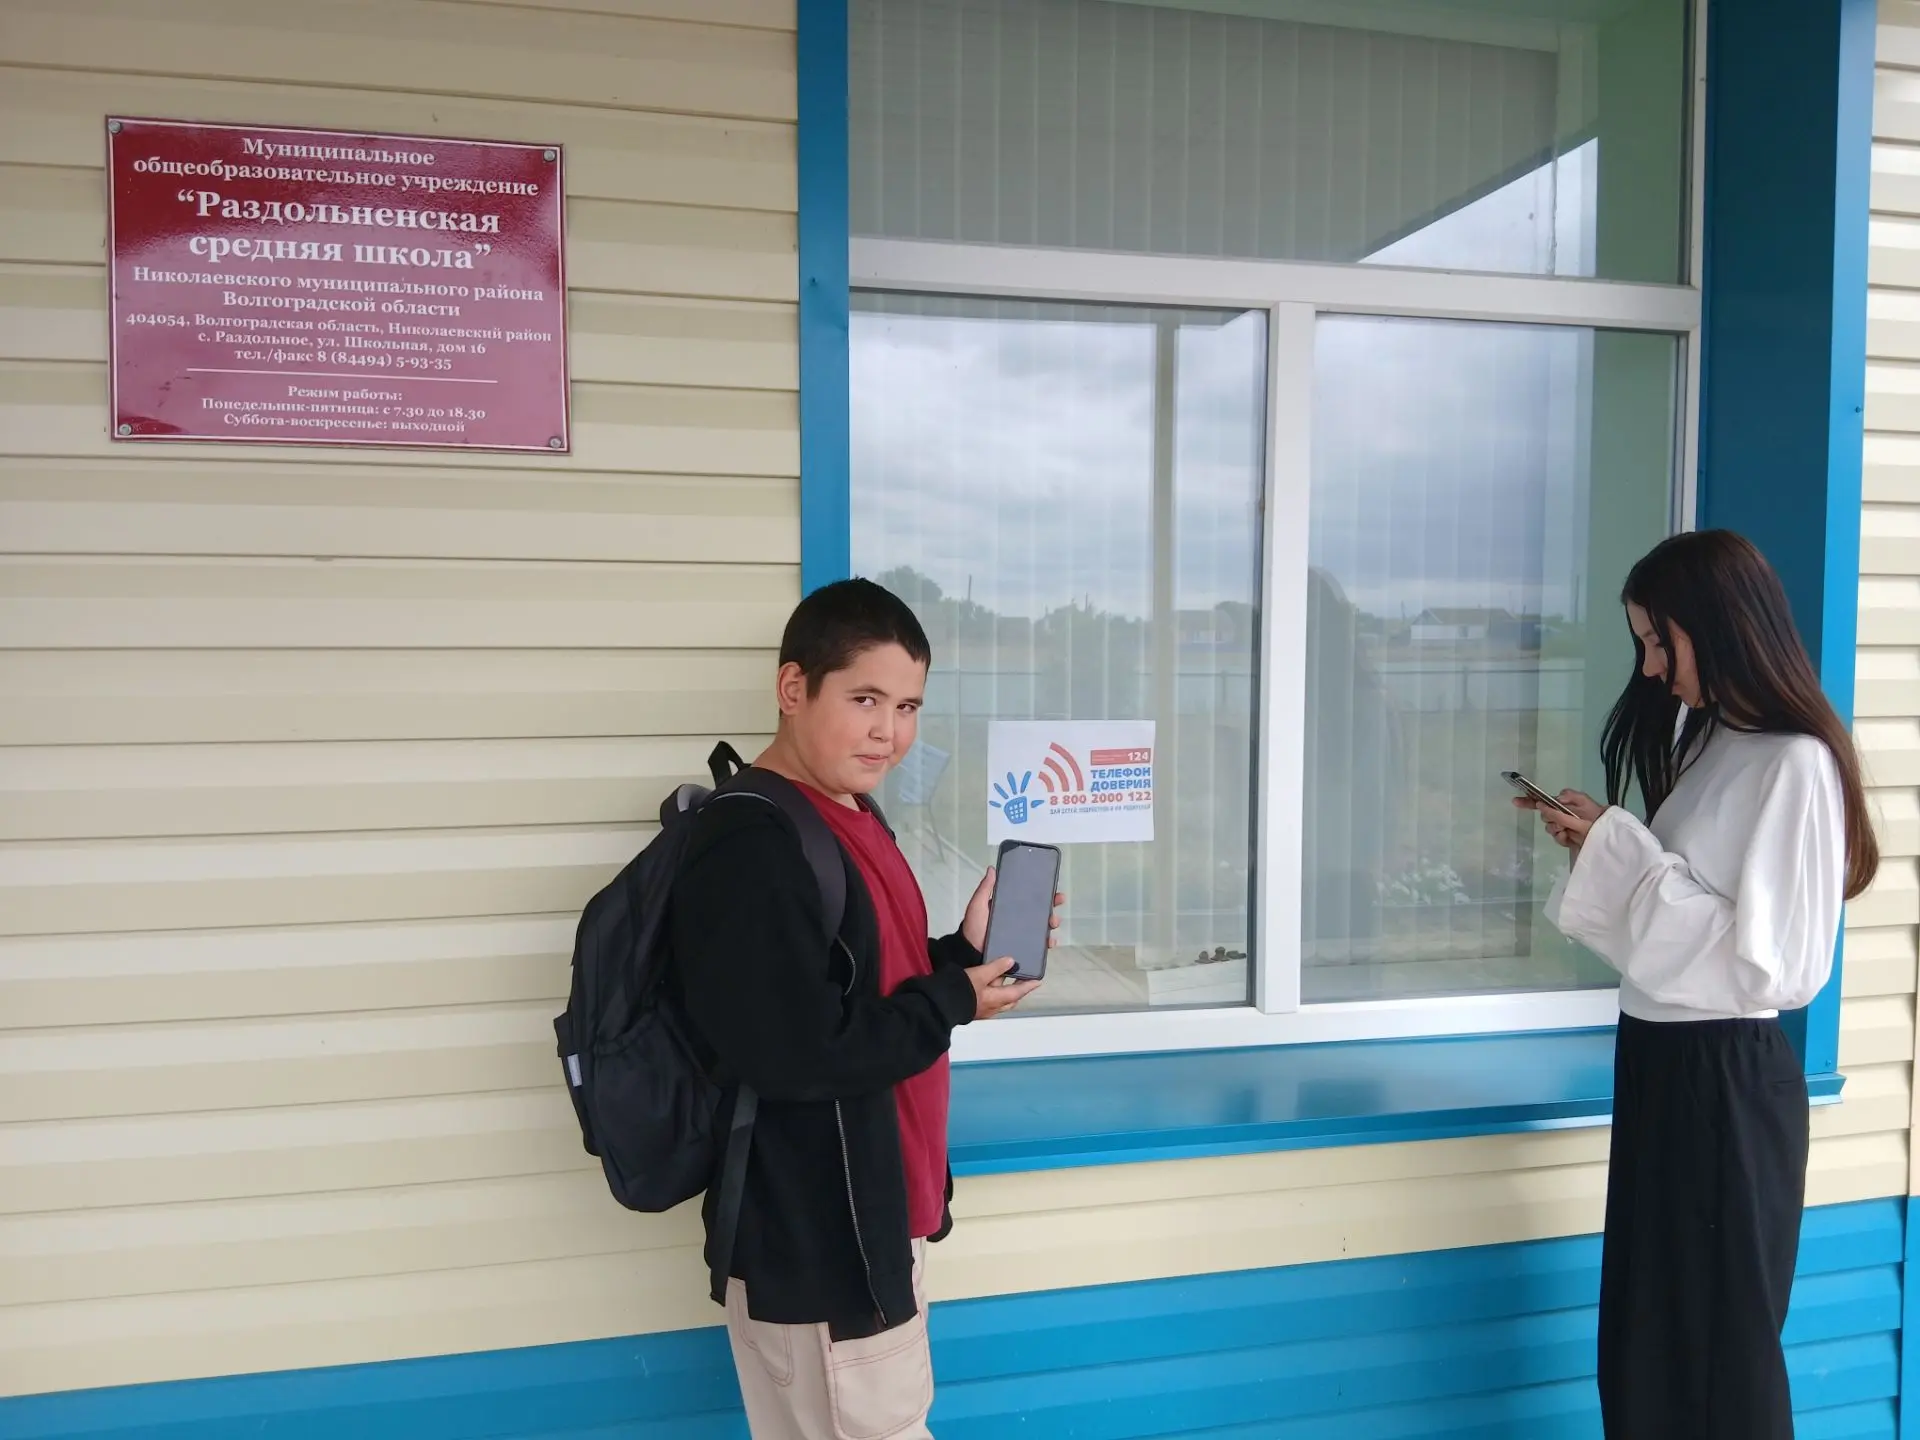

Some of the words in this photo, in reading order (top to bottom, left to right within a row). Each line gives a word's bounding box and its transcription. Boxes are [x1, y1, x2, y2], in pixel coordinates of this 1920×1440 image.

[242, 137, 435, 165] Муниципальное
[133, 156, 396, 186] общеобразовательное
[401, 173, 539, 197] учреждение
[189, 235, 344, 264] средняя
[133, 266, 292, 289] Николаевского
[297, 276, 469, 298] муниципального
[473, 283, 544, 302] района
[222, 291, 376, 313] Волгоградской
[381, 299, 461, 317] области
[195, 313, 314, 331] Волгоградская
[317, 319, 384, 335] область,
[388, 322, 502, 340] Николаевский
[505, 328, 551, 343] район
[198, 331, 210, 343] с.
[215, 331, 314, 347] Раздольное,
[317, 337, 340, 349] ул.
[344, 336, 433, 353] Школьная,
[436, 343, 466, 355] дом
[470, 342, 486, 354] 16
[234, 348, 314, 363] тел./факс
[317, 350, 327, 362] 8
[331, 351, 392, 369] (84494)
[396, 355, 452, 371] 5-93-35
[287, 385, 339, 399] Режим
[343, 388, 403, 402] работы:
[202, 397, 379, 416] Понедельник-пятница:
[383, 406, 391, 415] с
[394, 406, 424, 418] 7.30
[427, 408, 445, 419] до
[449, 407, 486, 420] 18.30
[391, 419, 465, 433] выходной
[1127, 751, 1148, 761] 124
[1090, 767, 1151, 779] ТЕЛЕФОН
[1090, 779, 1151, 792] ДОВЕРИЯ
[1049, 795, 1058, 806] 8
[1062, 794, 1087, 805] 800
[1091, 792, 1123, 804] 2000
[1127, 791, 1152, 802] 122
